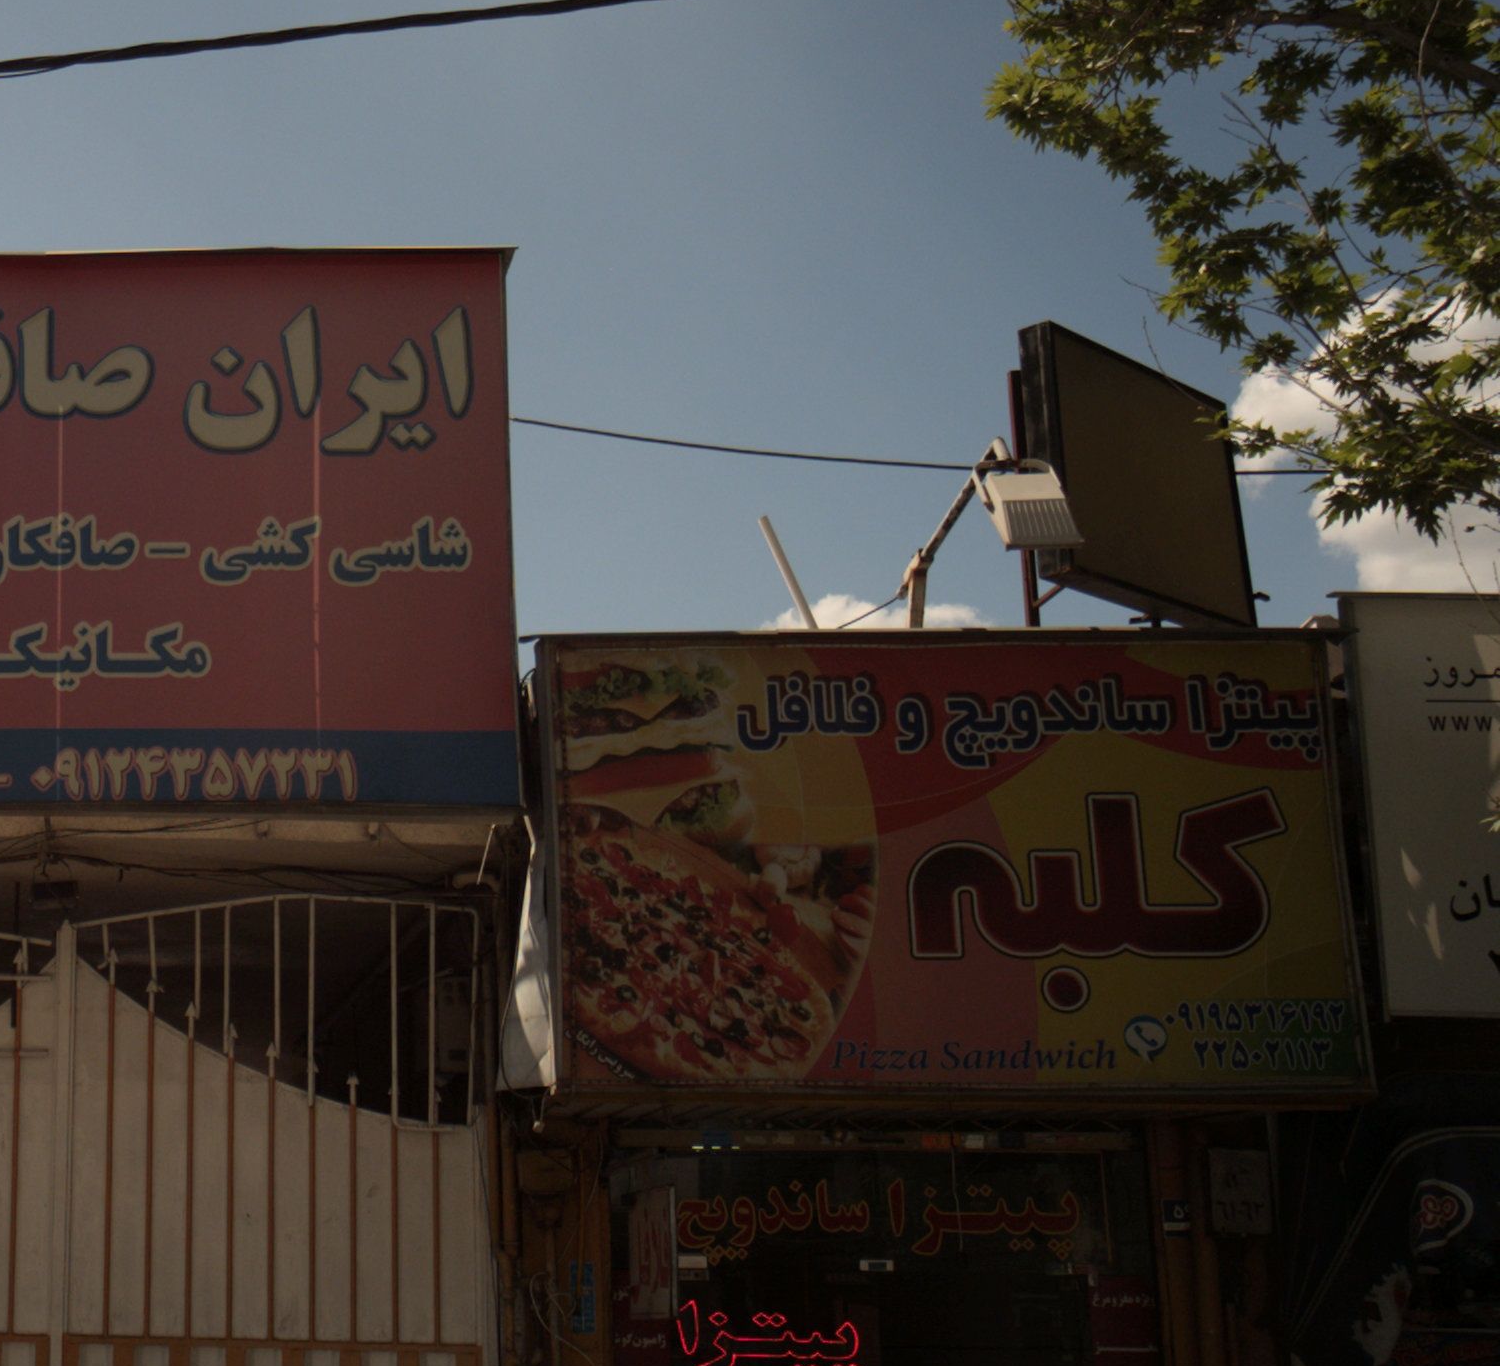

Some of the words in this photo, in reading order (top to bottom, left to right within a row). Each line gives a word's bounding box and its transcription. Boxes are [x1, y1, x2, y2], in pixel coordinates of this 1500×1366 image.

[183, 302, 476, 456] ایران
[199, 515, 322, 586] کشی
[328, 516, 471, 585] شاسی
[736, 673, 882, 753] فلافل
[896, 695, 931, 753] و
[943, 675, 1172, 769] ساندویچ
[1186, 673, 1324, 762] پیتزا
[908, 785, 1289, 1014] کلبه
[831, 1040, 929, 1071] Pizza
[940, 1039, 1118, 1071] Sandwich
[676, 1177, 870, 1266] ساندویچ
[887, 1177, 1081, 1261] پیتزا
